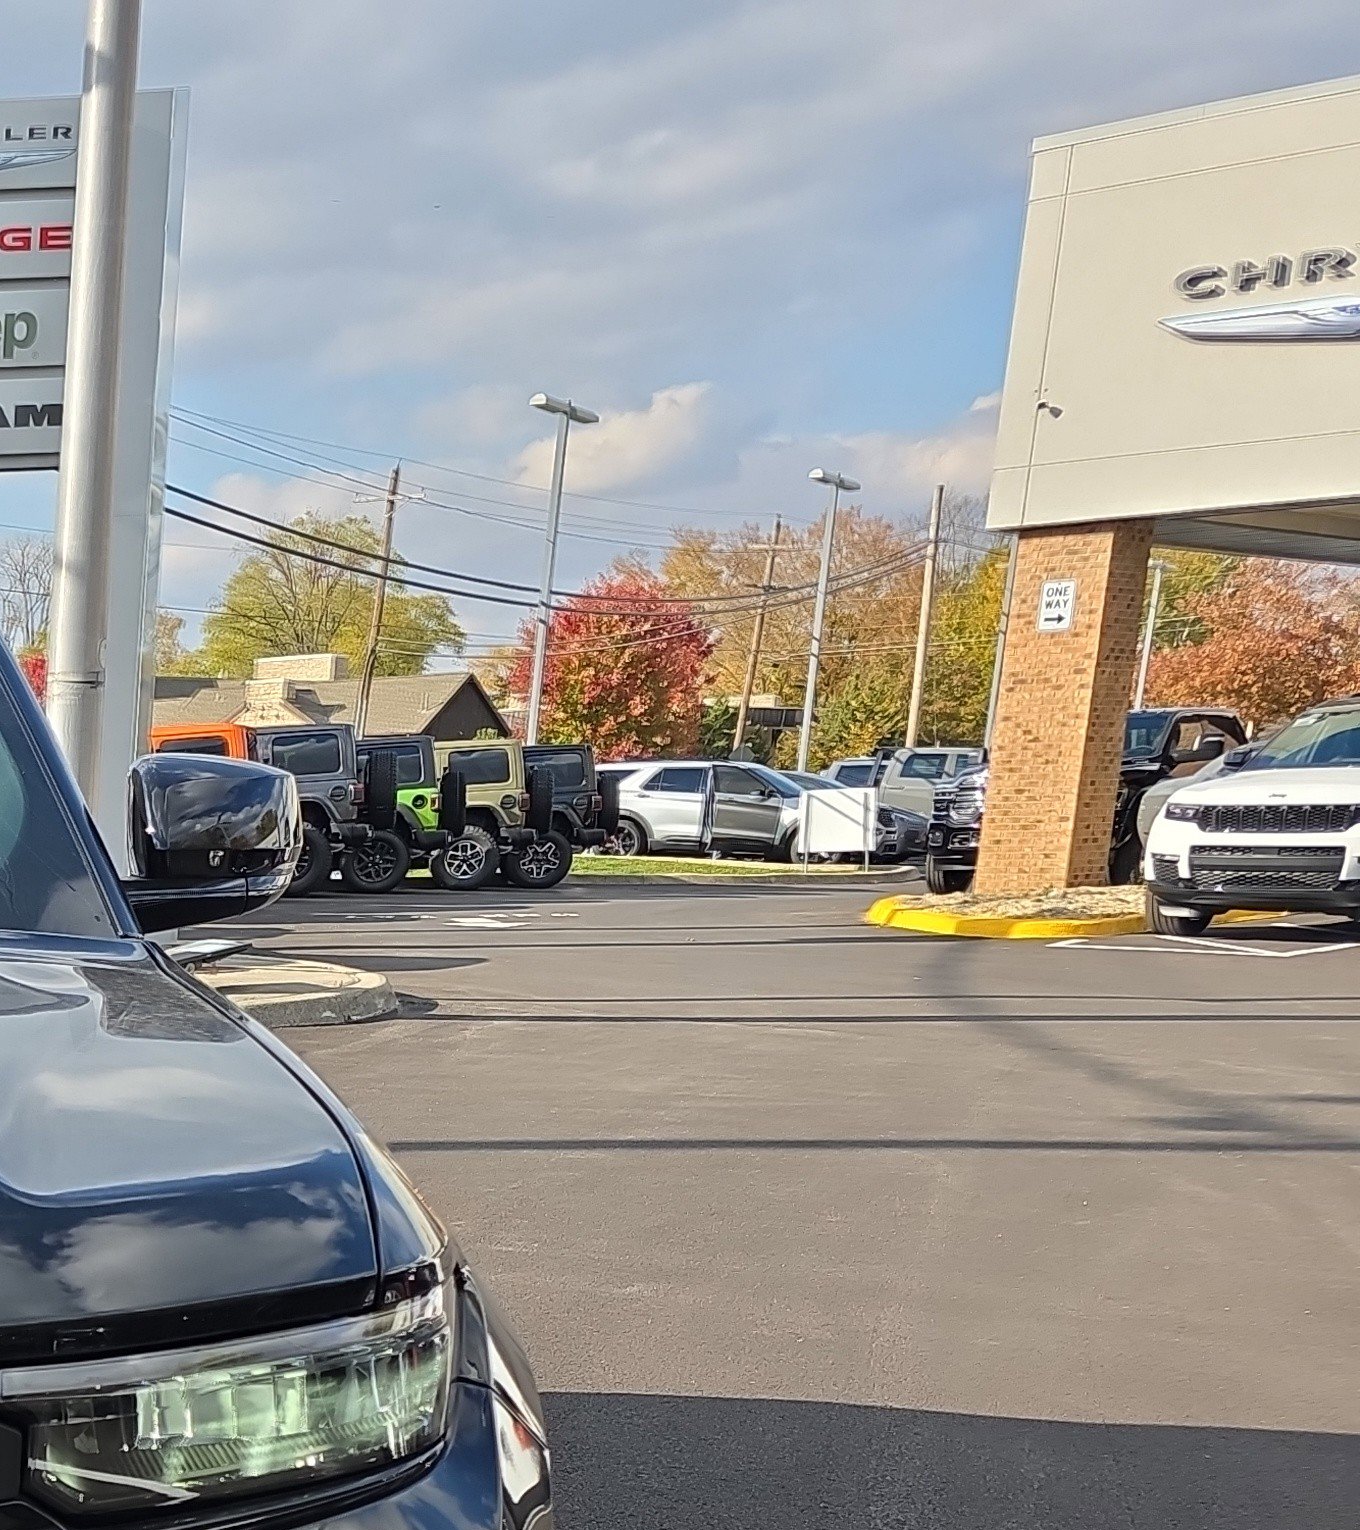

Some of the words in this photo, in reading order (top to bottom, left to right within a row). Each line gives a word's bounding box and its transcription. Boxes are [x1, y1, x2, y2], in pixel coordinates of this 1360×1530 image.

[1172, 242, 1360, 302] CHR
[1046, 586, 1070, 598] ONE
[1045, 598, 1070, 610] WAY
